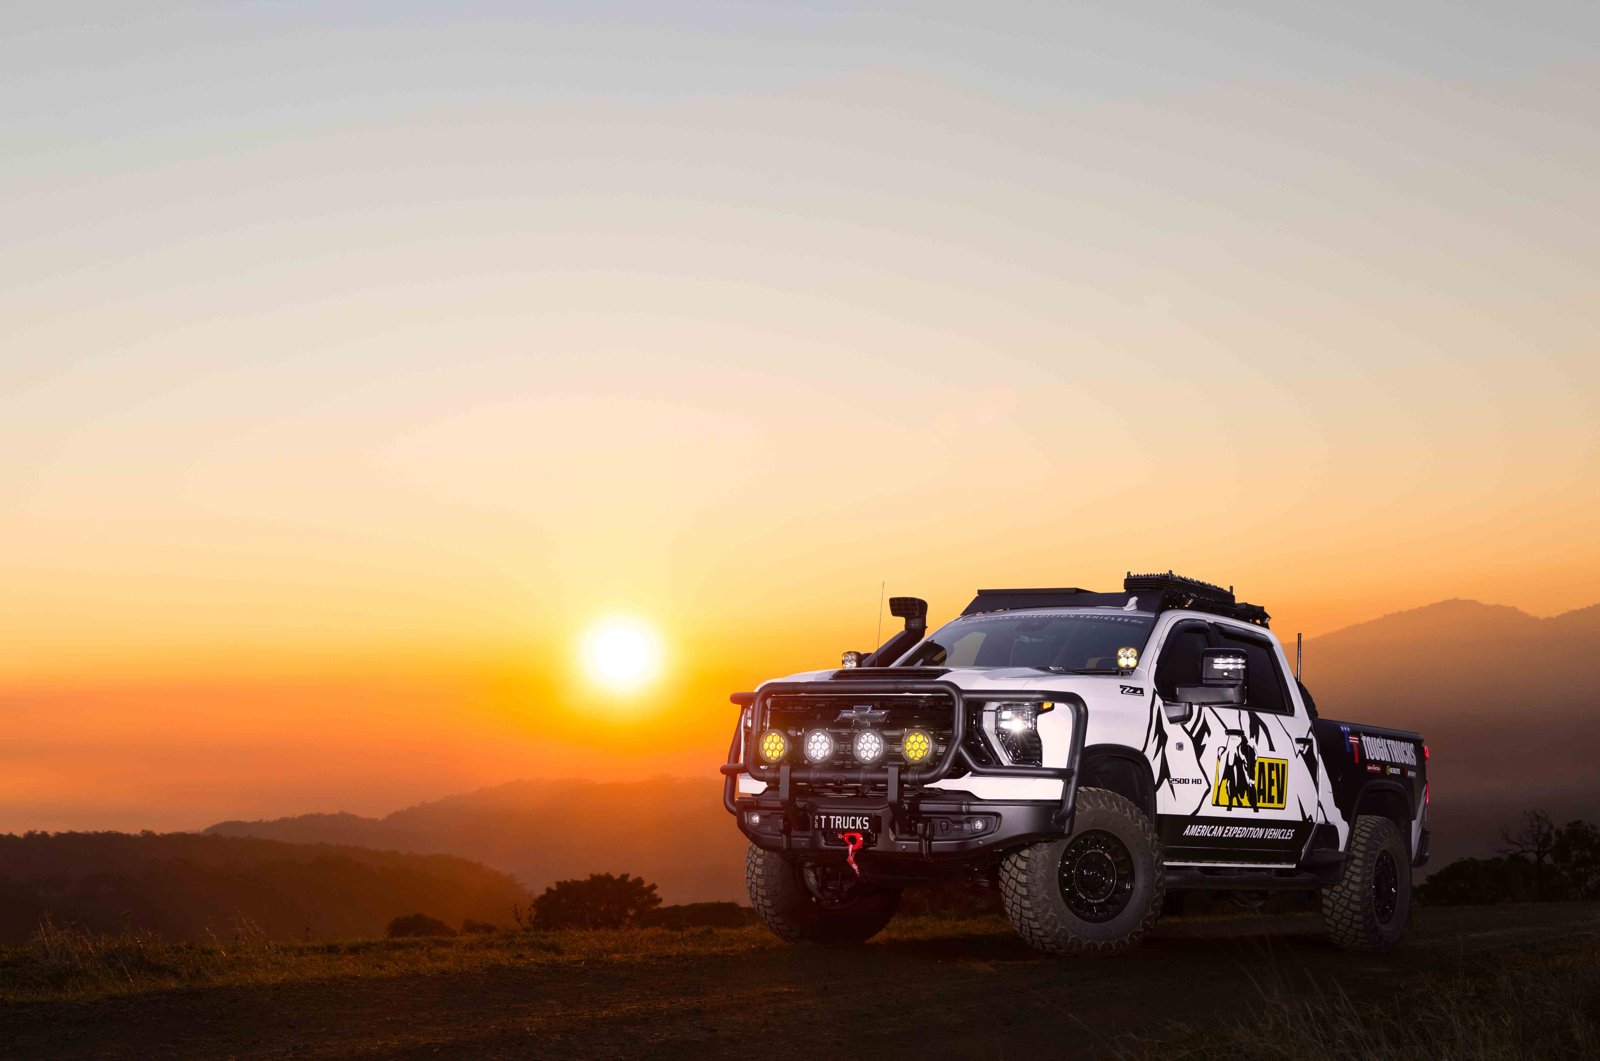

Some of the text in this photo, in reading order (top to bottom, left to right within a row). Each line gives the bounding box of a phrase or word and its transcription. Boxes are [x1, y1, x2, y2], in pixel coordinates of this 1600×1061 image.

[1079, 614, 1129, 622] VEHICLES
[1361, 736, 1416, 766] TOUGH TRUCKS
[1169, 777, 1190, 785] 2500
[1257, 761, 1286, 804] AEV
[820, 815, 869, 829] T TRUCKS
[1182, 825, 1295, 840] AMERICAN EXPEDITION VEHICLES
